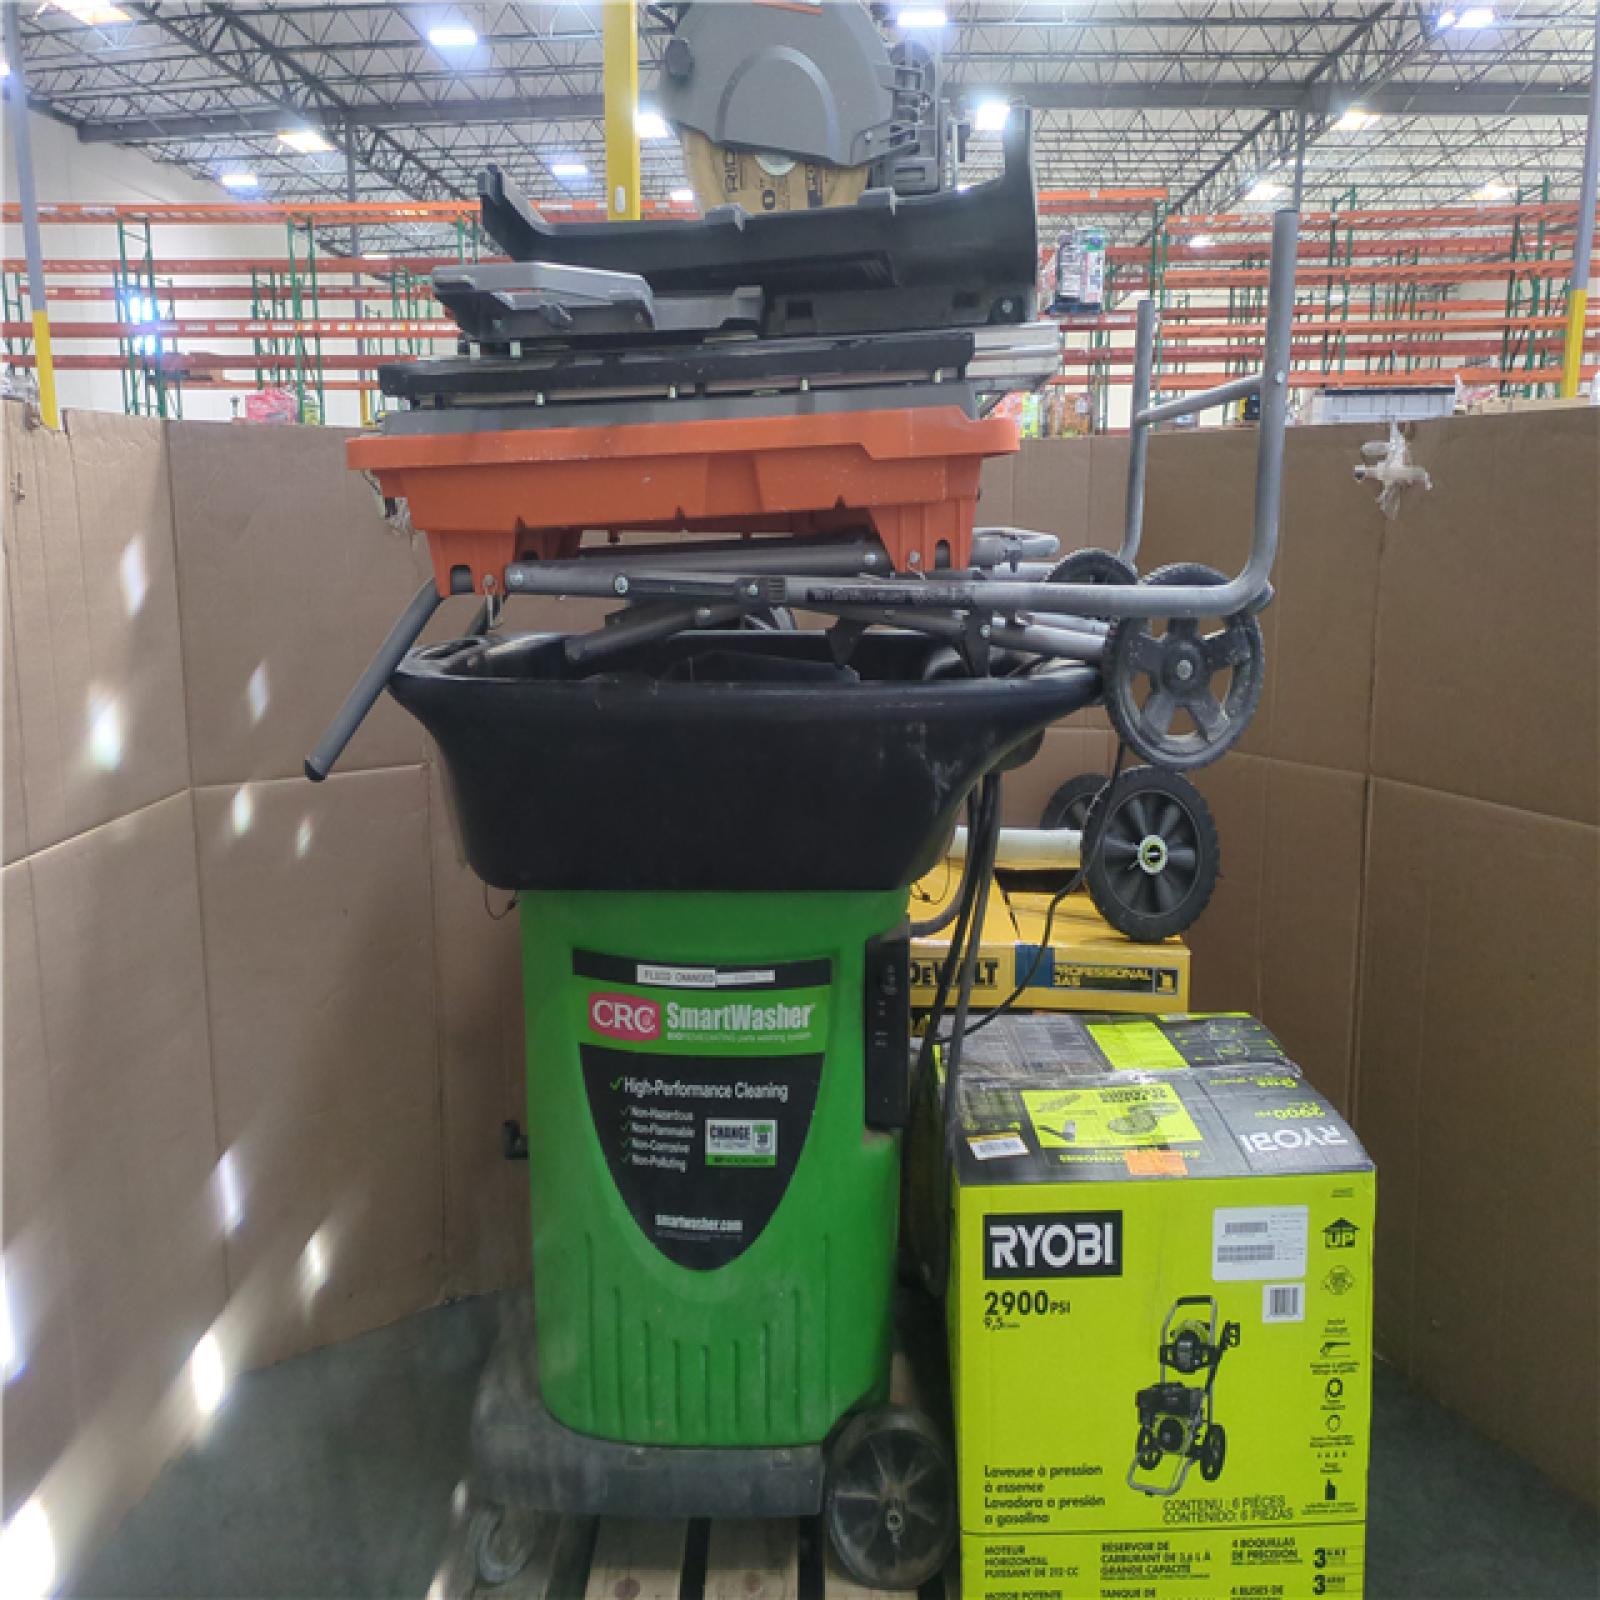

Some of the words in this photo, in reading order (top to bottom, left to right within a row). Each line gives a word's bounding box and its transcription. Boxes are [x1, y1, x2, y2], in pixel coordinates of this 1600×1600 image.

[910, 960, 998, 986] DELT
[592, 999, 656, 1033] CRC
[667, 1002, 812, 1031] SmartWasher
[624, 1076, 731, 1098] High-Performance
[734, 1080, 789, 1103] Cleaning
[1238, 1124, 1349, 1154] RYOBI
[989, 1222, 1114, 1268] RYOBI
[984, 1289, 1048, 1316] 2900
[1050, 1300, 1070, 1314] PSI
[985, 1464, 1035, 1478] Laveuse
[1050, 1462, 1103, 1480] pression
[997, 1483, 1045, 1493] essence
[985, 1495, 1043, 1508] Lavadora
[1059, 1494, 1105, 1510] presión
[997, 1511, 1050, 1528] gasolina
[1313, 1547, 1326, 1569] 3
[1313, 1574, 1325, 1595] 3
